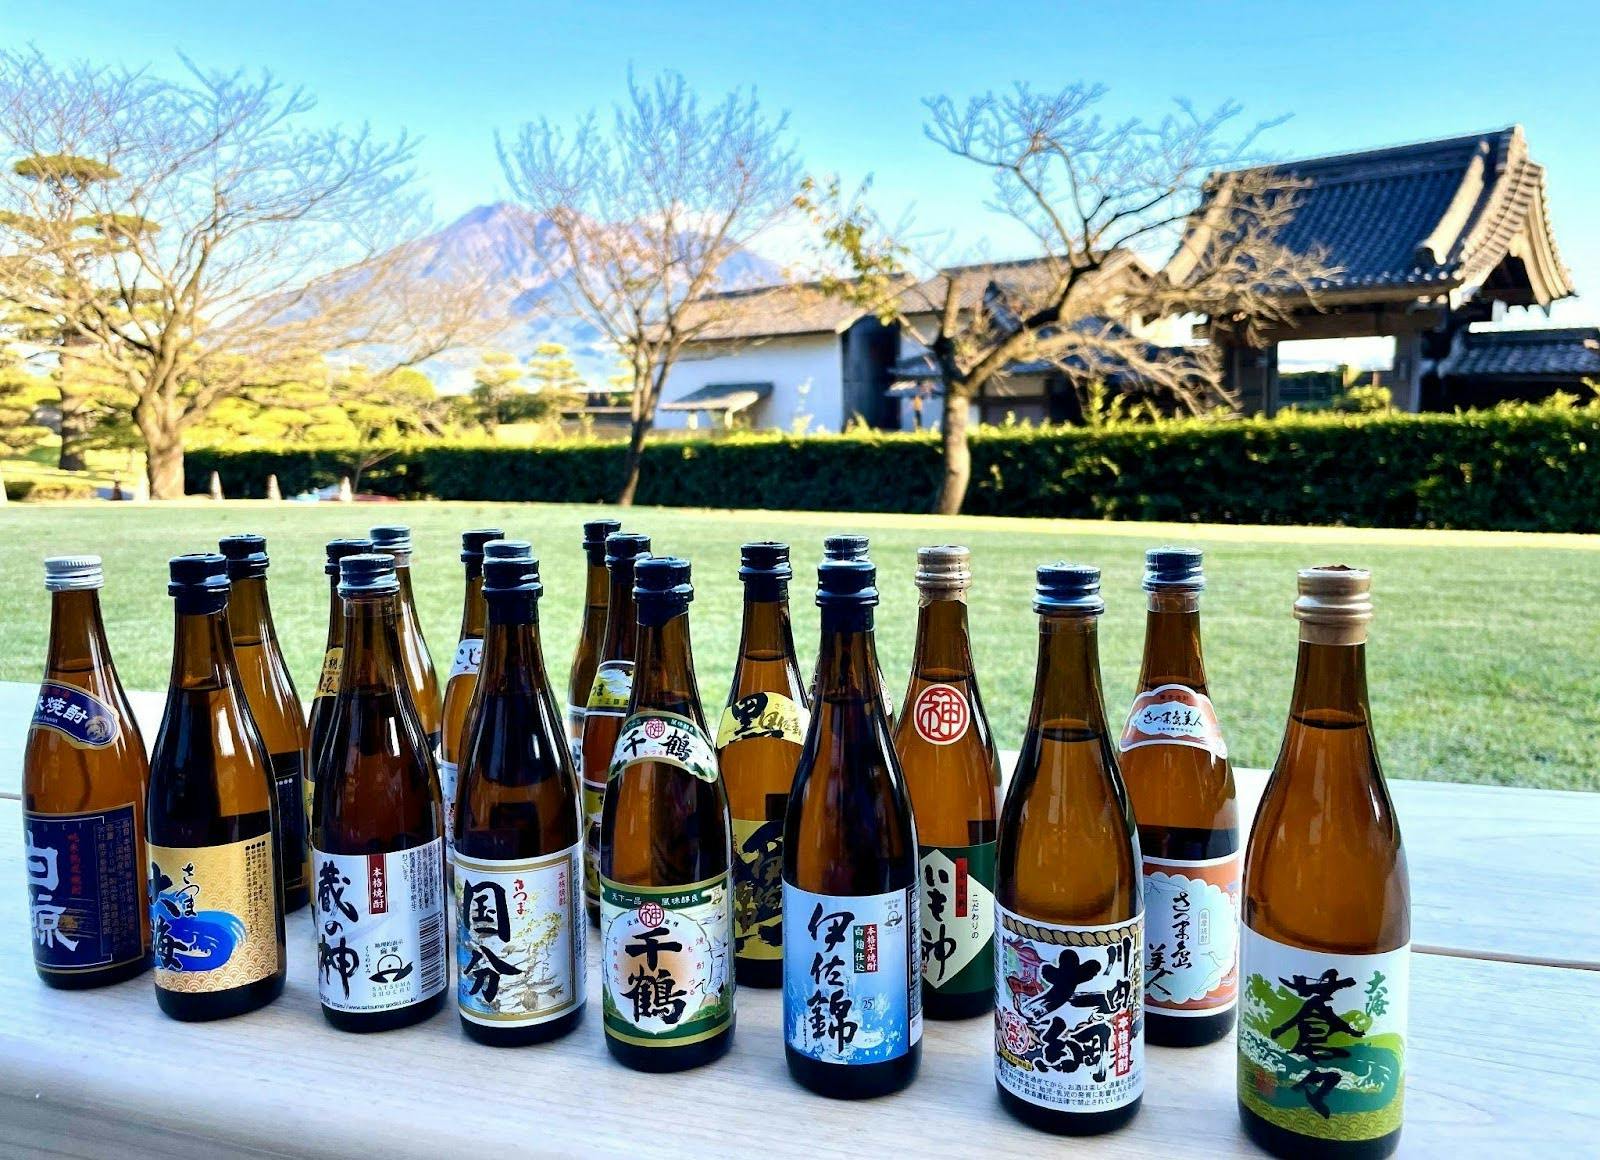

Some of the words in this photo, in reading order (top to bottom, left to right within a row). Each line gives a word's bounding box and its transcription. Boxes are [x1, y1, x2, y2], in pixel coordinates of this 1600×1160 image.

[916, 686, 969, 742] 神
[623, 729, 693, 762] 千鶴
[372, 867, 384, 908] 本格焼酎
[513, 878, 528, 915] さつま
[317, 861, 360, 999] 蔵の神
[463, 878, 525, 1004] 国分
[921, 864, 957, 981] いも神
[372, 981, 411, 993] SATSUMA
[620, 927, 687, 1024] 千鶴
[807, 902, 858, 1053] 伊佐錦
[863, 999, 873, 1009] 25
